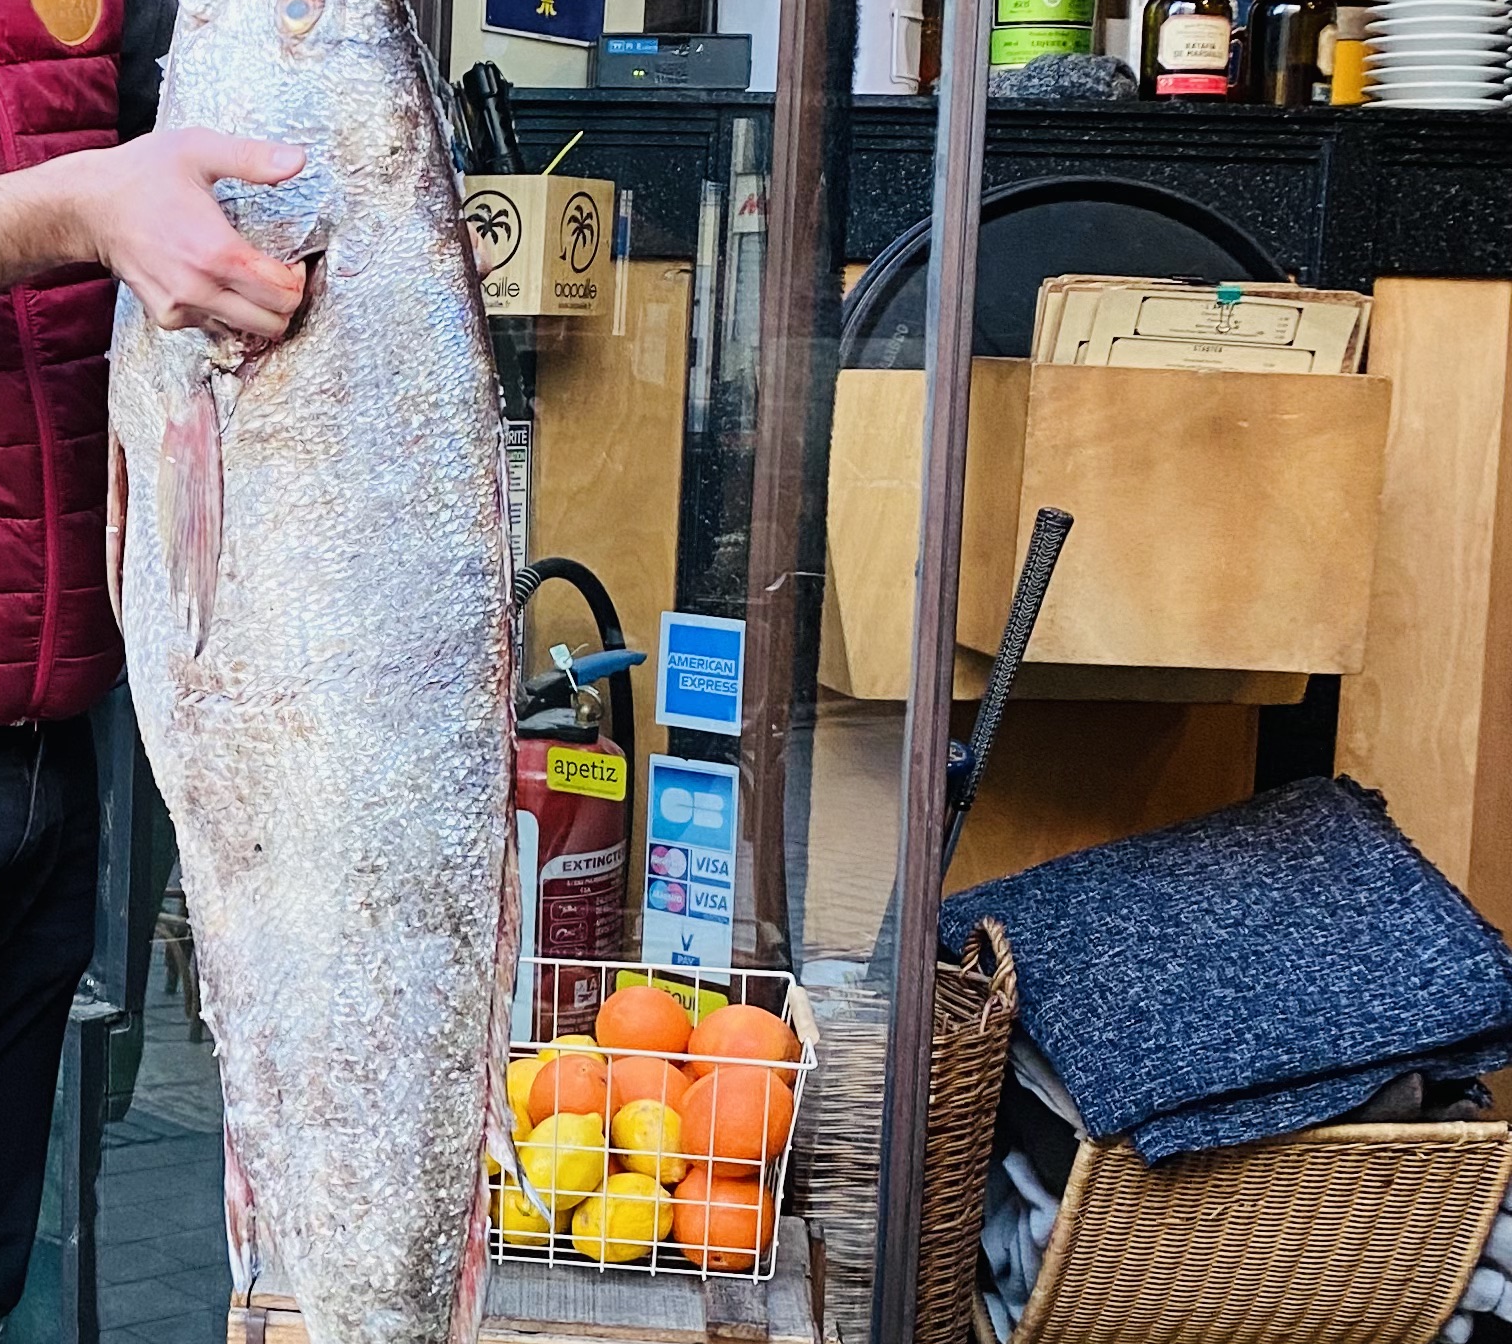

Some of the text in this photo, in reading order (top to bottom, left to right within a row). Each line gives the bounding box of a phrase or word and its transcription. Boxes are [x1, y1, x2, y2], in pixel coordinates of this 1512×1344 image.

[668, 654, 734, 674] AMERICAN
[680, 674, 739, 694] EXPRESS
[553, 759, 619, 783] apetiz
[696, 856, 730, 877] VISA
[695, 891, 728, 912] VISA
[676, 954, 696, 966] PAY
